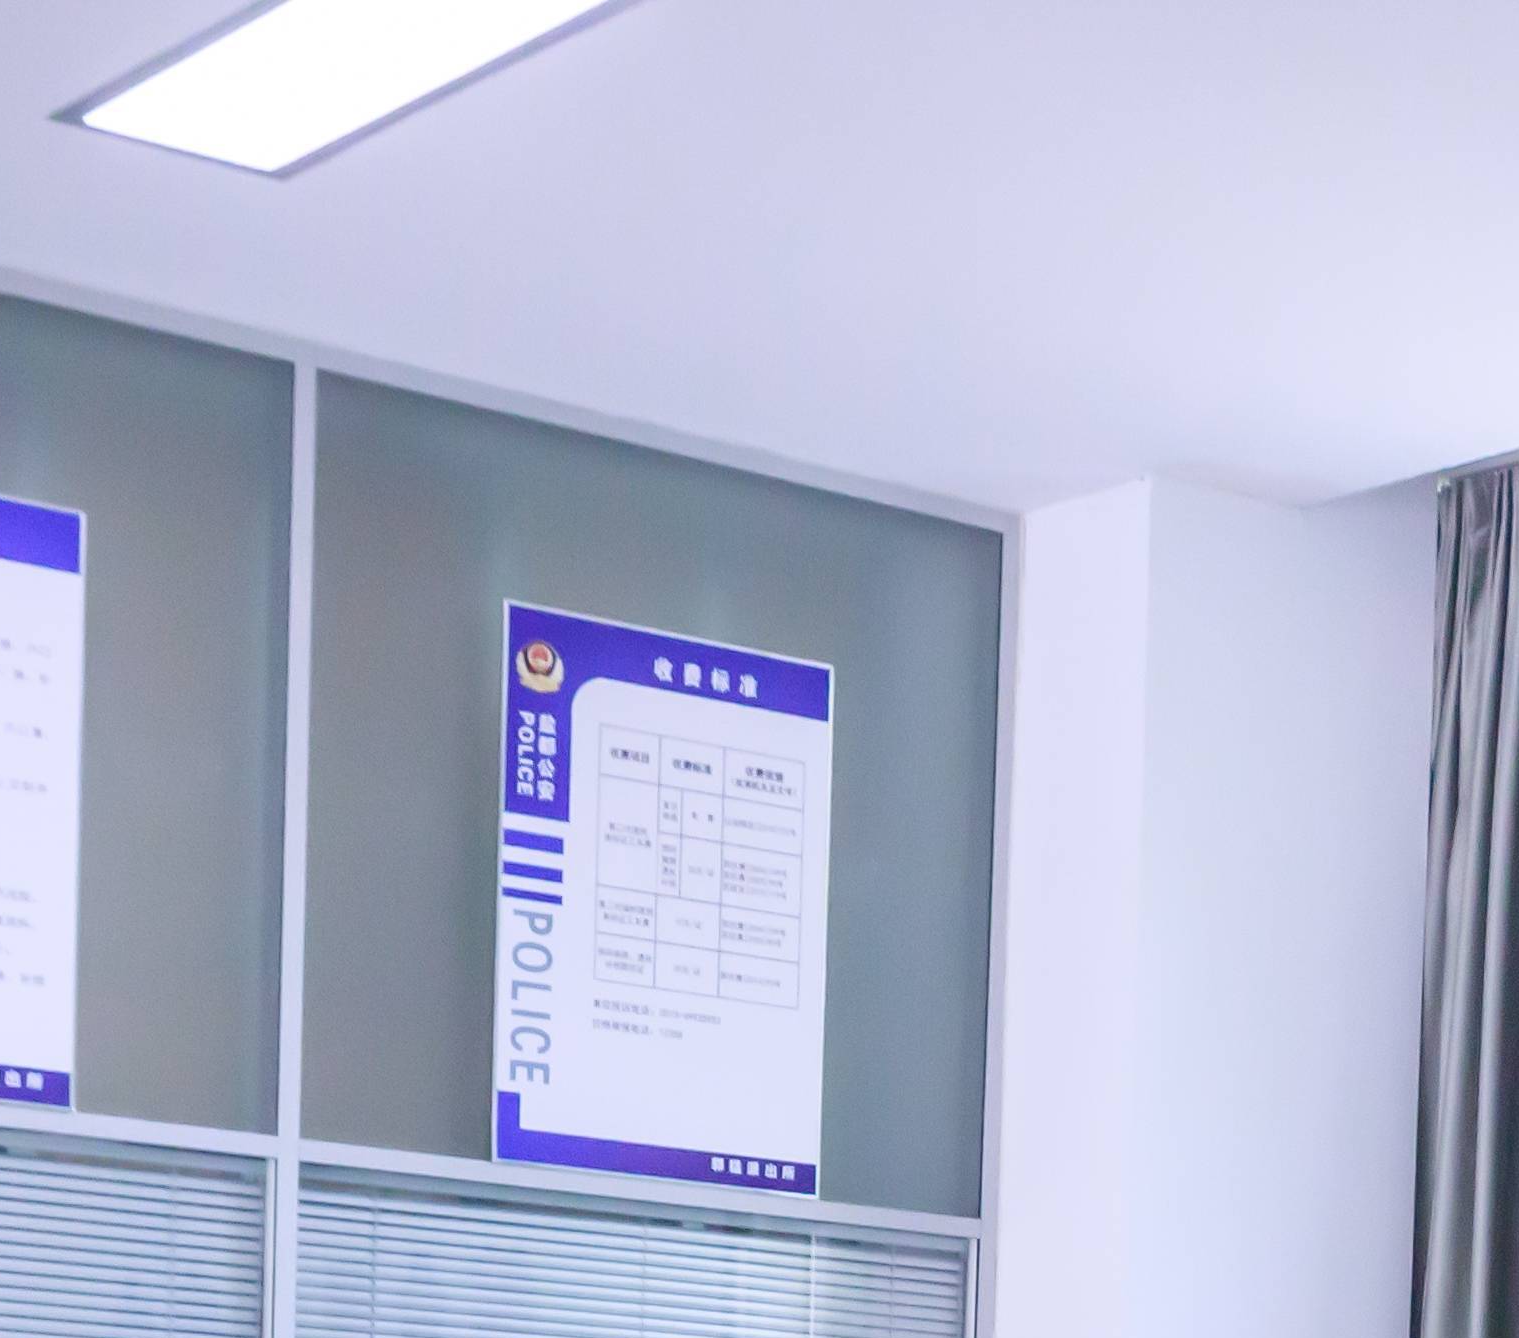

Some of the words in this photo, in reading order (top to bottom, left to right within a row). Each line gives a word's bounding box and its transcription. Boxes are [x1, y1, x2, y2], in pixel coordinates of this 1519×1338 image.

[653, 656, 758, 699] 收费标准
[516, 709, 536, 797] POLICE
[508, 908, 555, 1087] POLICE
